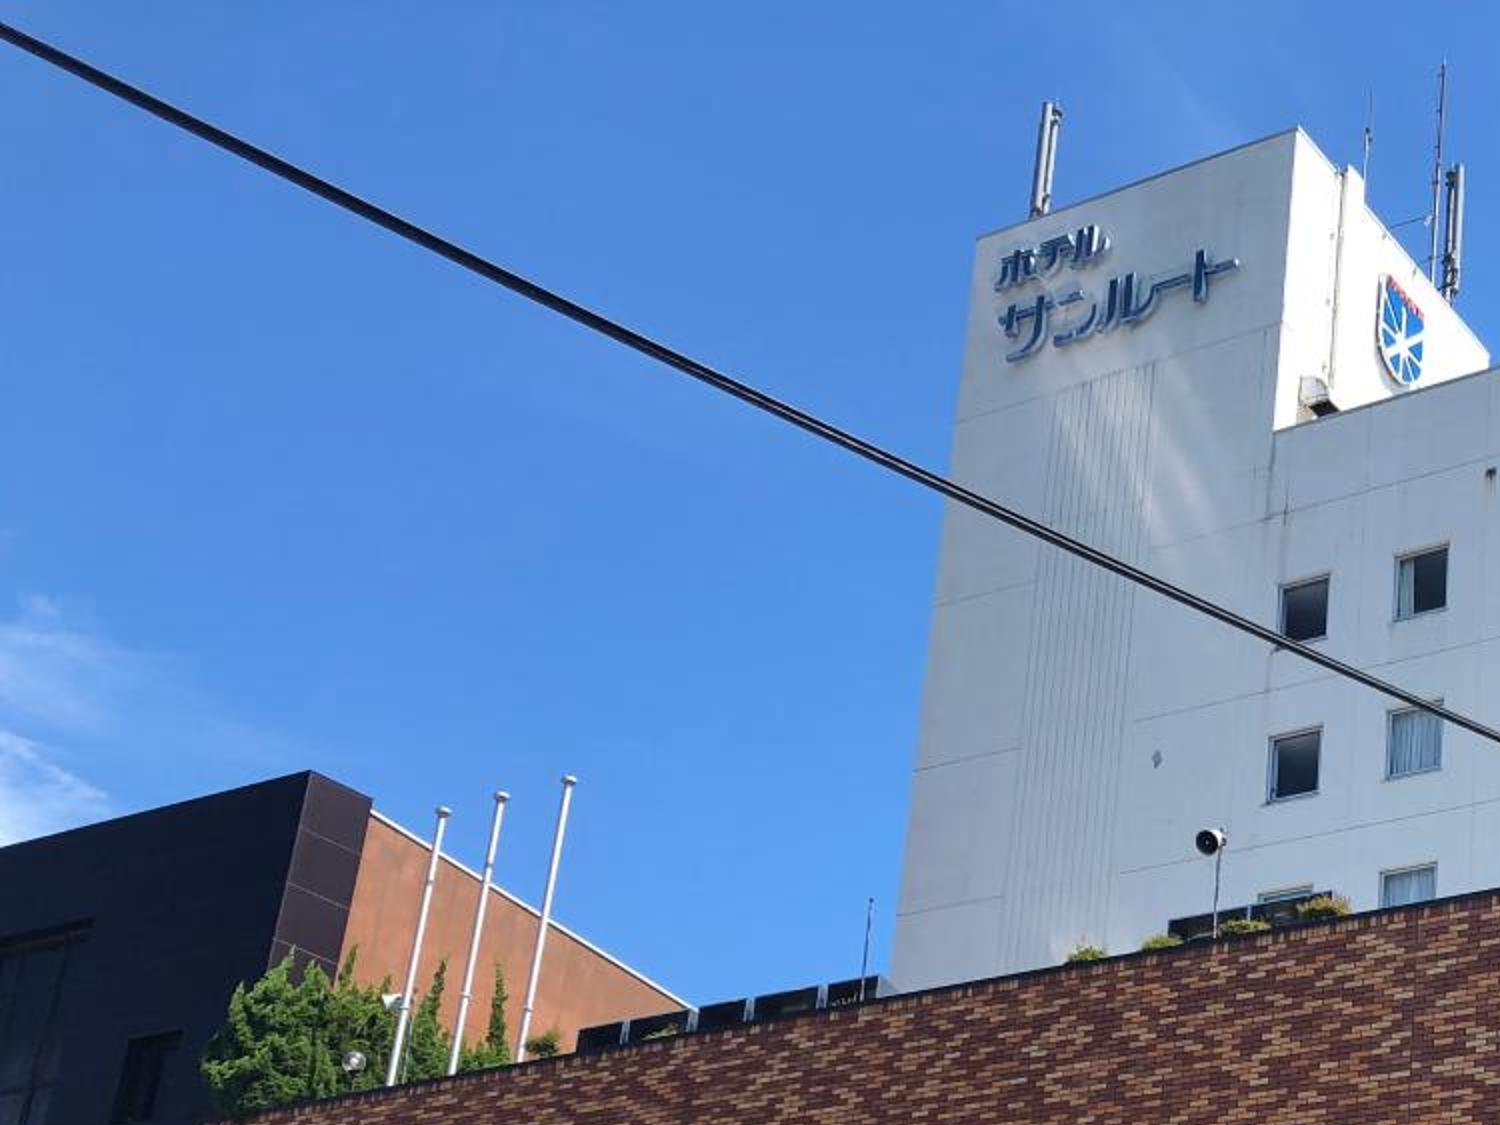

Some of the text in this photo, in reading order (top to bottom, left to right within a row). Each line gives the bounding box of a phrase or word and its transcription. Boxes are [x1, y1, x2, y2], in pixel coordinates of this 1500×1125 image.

[995, 224, 1112, 291] ホテル
[999, 249, 1240, 362] サンルート
